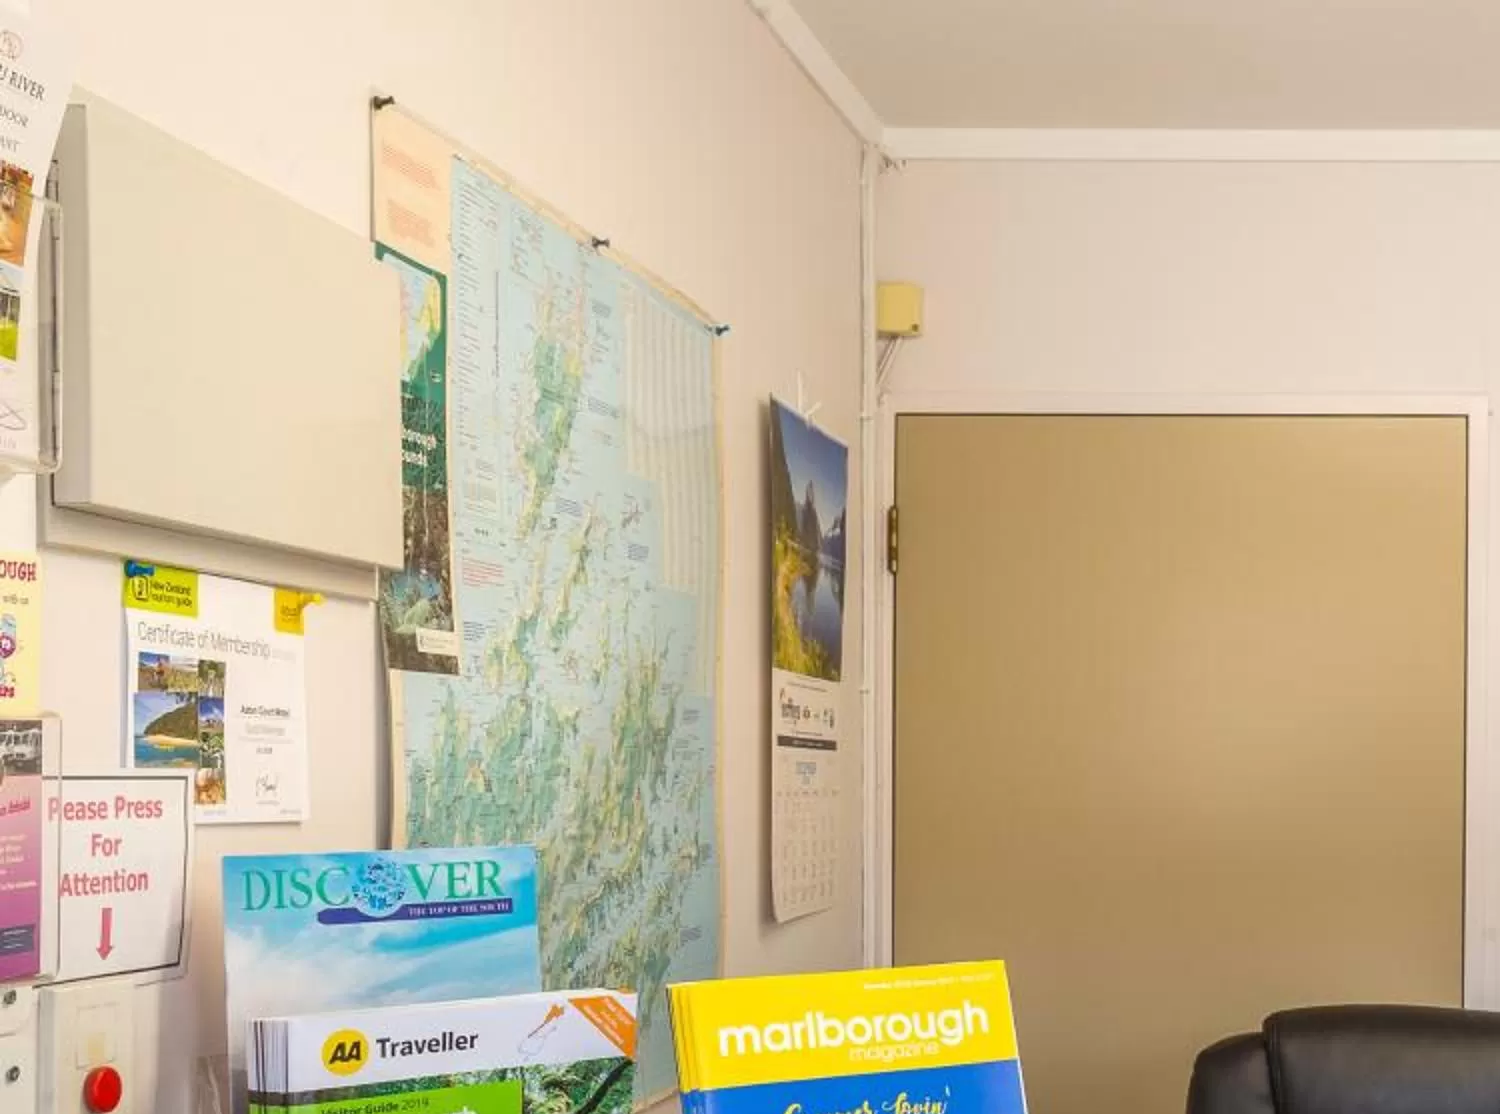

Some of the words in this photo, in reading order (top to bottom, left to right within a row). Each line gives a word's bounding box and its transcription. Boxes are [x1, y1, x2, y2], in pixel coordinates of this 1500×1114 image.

[10, 70, 45, 101] RIVER
[137, 620, 196, 649] Certificate
[198, 630, 209, 649] of
[210, 633, 271, 660] Membership
[48, 797, 109, 822] Pease
[114, 795, 163, 820] Press
[91, 833, 123, 857] For
[60, 868, 150, 897] Attention
[718, 999, 990, 1058] marlborough
[329, 1039, 363, 1066] AA
[375, 1030, 480, 1060] Traveller
[848, 1039, 940, 1064] magazine
[364, 1101, 399, 1114] Guide
